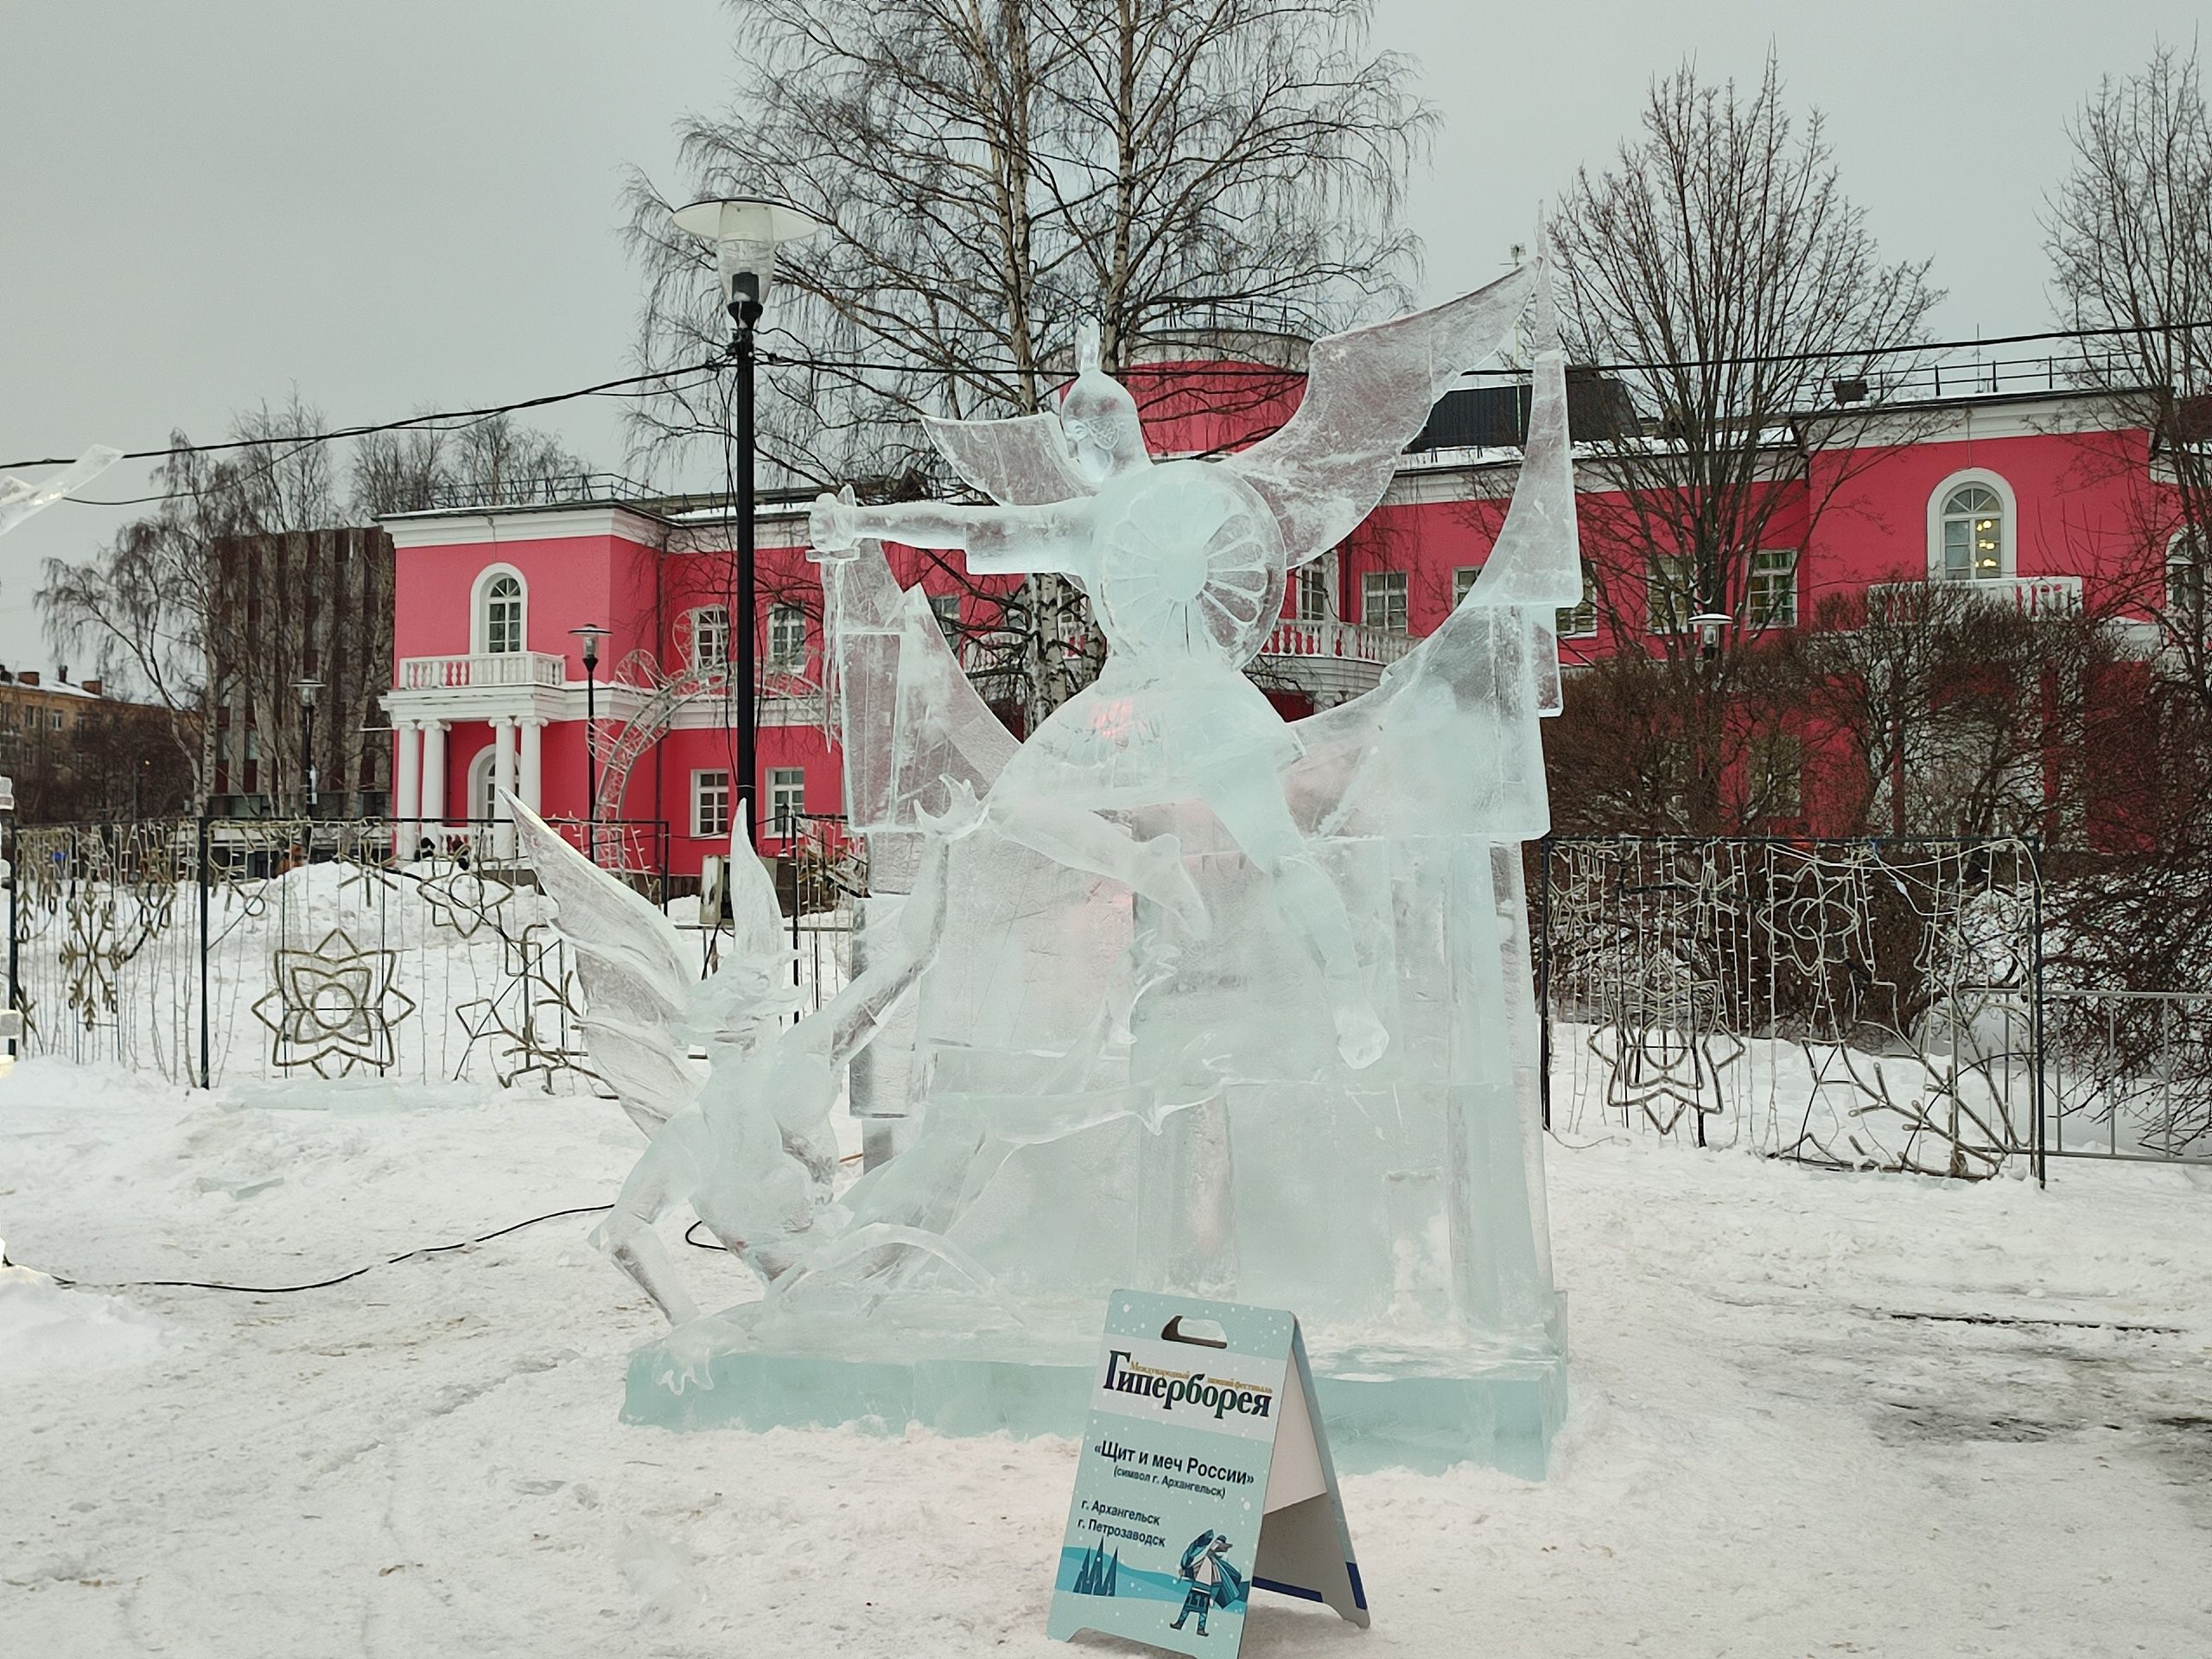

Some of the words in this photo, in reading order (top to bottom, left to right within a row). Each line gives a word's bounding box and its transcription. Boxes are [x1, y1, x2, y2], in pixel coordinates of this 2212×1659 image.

[1103, 1350, 1273, 1420] Гиперборея
[1094, 1440, 1135, 1463] «Щит
[1138, 1452, 1148, 1465] и
[1152, 1454, 1183, 1472] меч
[1186, 1458, 1255, 1485] России»
[1114, 1465, 1150, 1483] (символ
[1152, 1475, 1160, 1484] г.
[1161, 1475, 1226, 1499] Архангельск)
[1081, 1499, 1090, 1510] г.
[1091, 1500, 1160, 1525] Архангельск
[1077, 1518, 1085, 1529] г.
[1088, 1519, 1166, 1548] Петрозаводск
